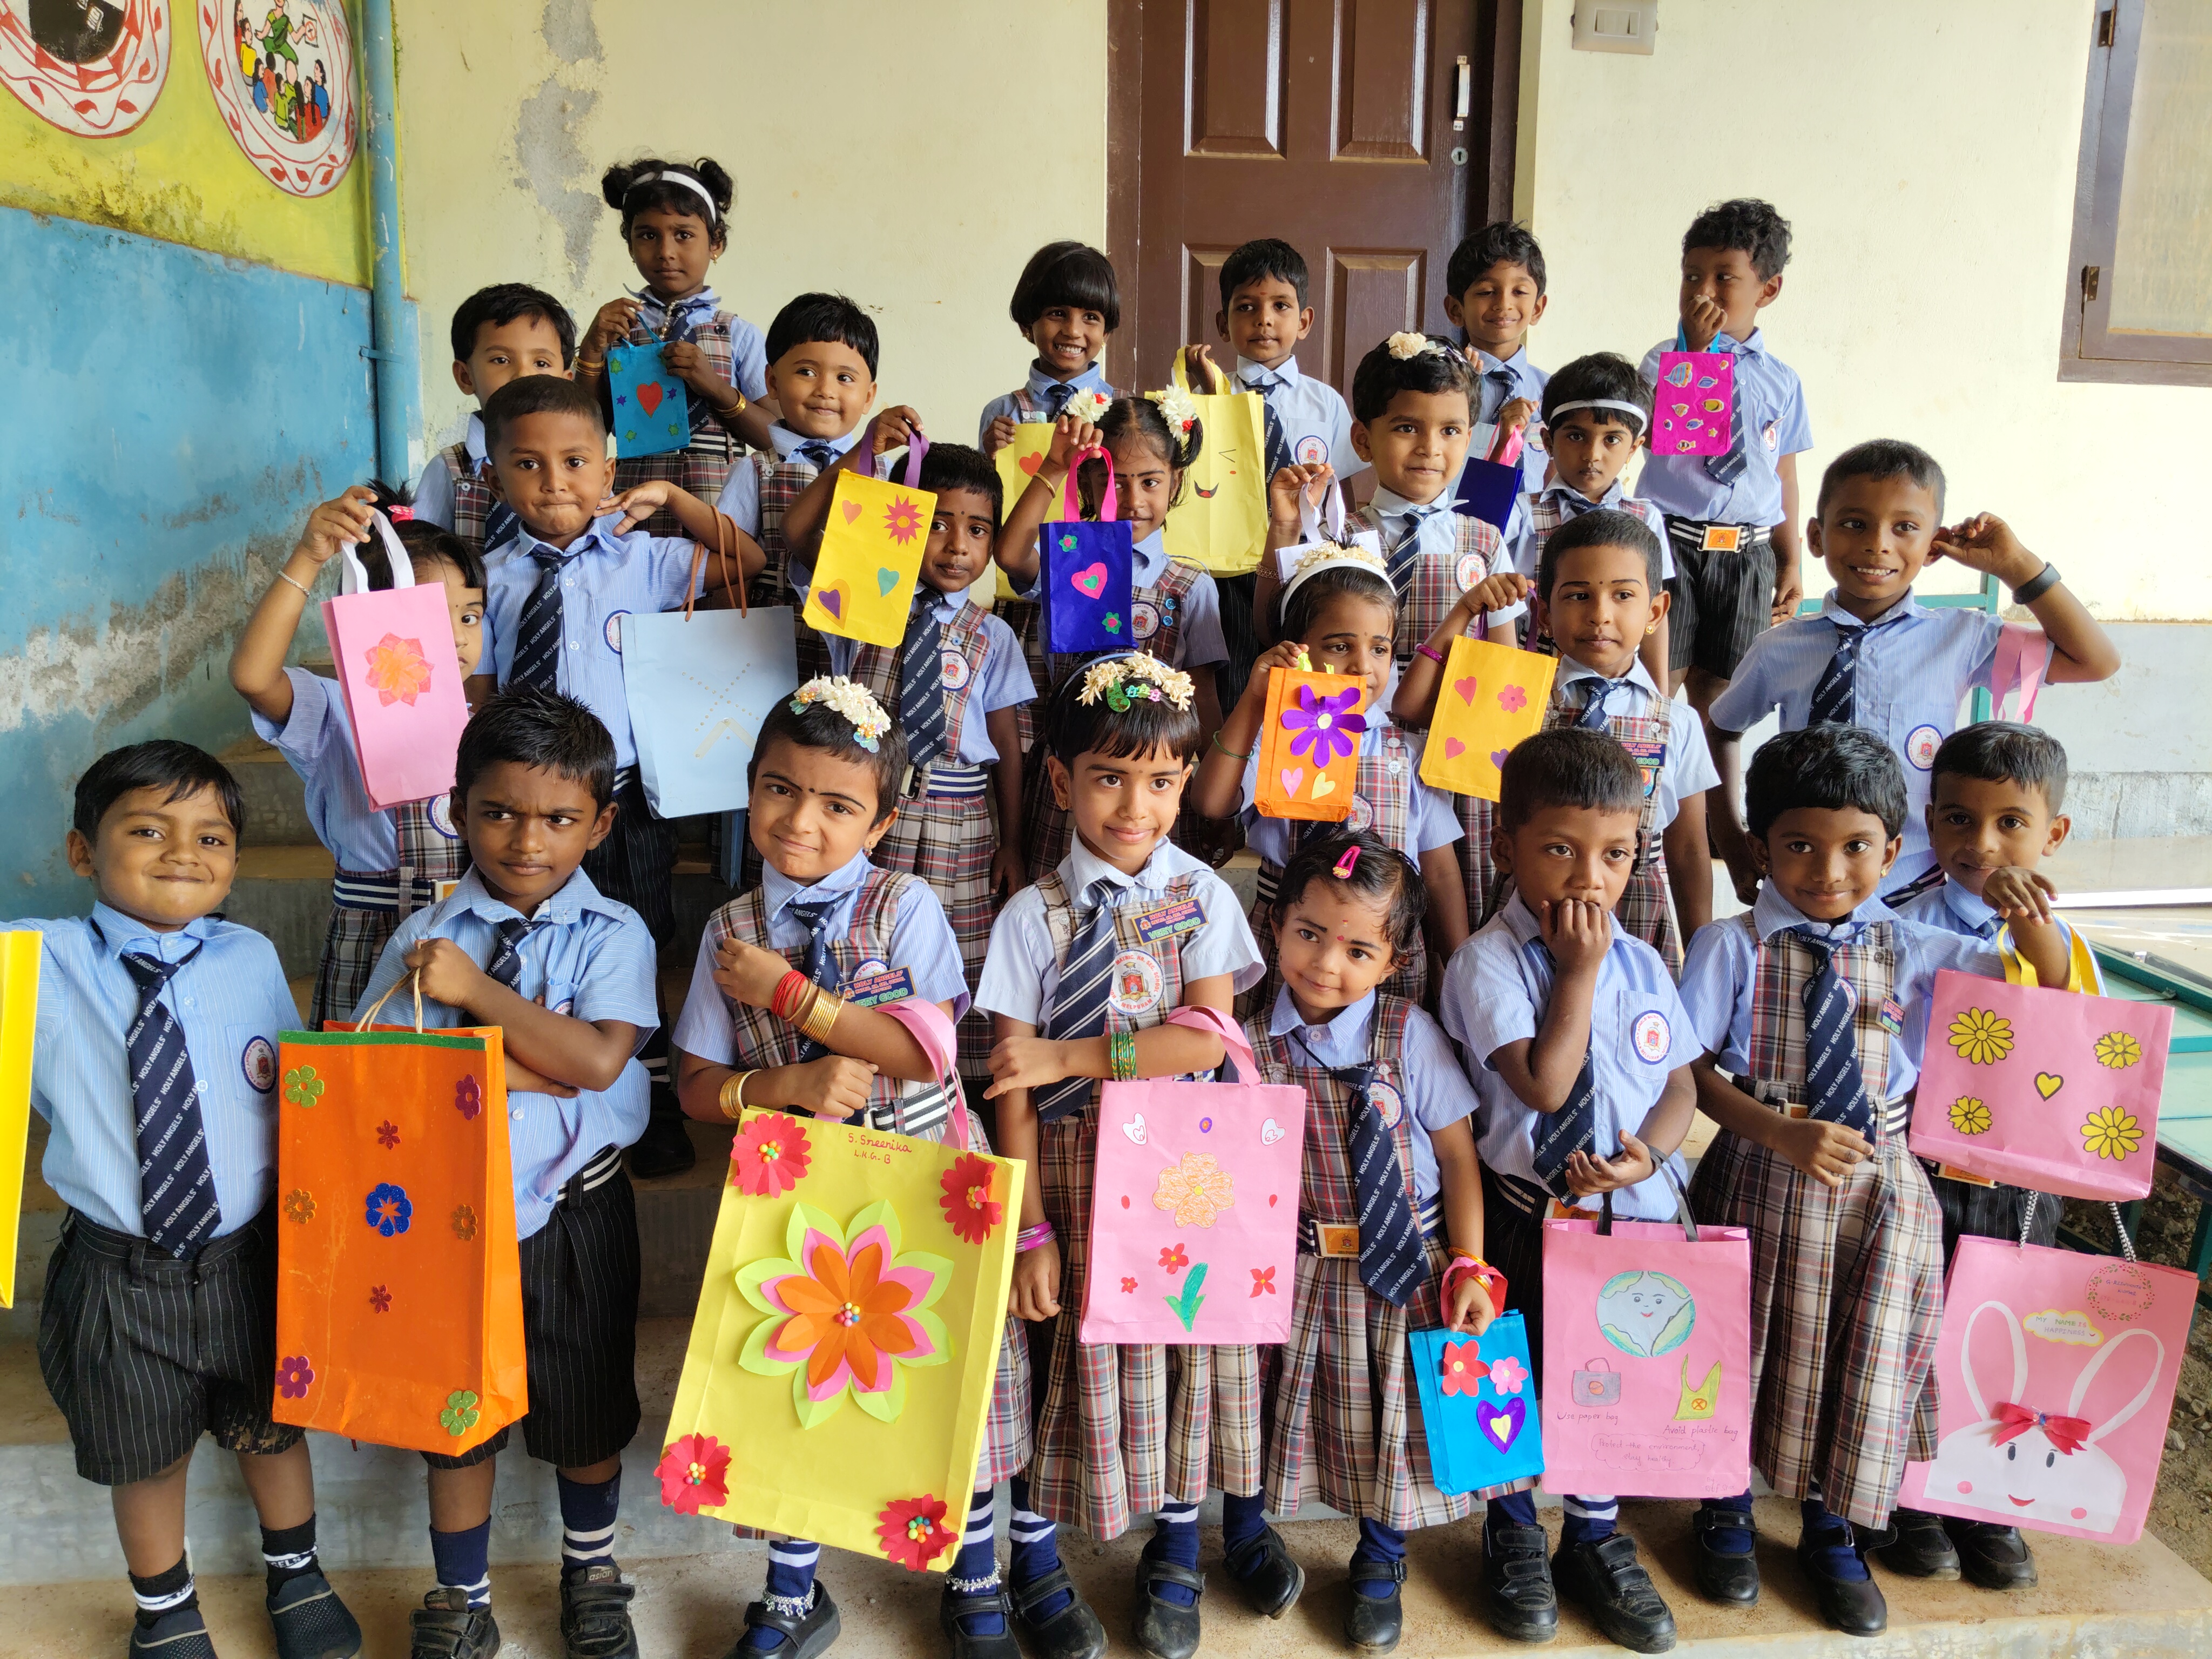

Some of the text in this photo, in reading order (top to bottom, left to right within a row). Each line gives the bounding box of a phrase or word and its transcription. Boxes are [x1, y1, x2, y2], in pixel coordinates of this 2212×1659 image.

[1719, 465, 1729, 475] HOLY
[496, 524, 506, 534] HOLY
[543, 588, 554, 600] HOLY
[527, 600, 542, 620] ANGELS'
[530, 615, 556, 645] HOLY ANGELS'
[542, 648, 553, 660] HOLY
[902, 637, 923, 665] HOLY ANGELS'
[524, 660, 541, 677] ANGELS'
[916, 650, 937, 678] HOLY ANGELS'
[901, 678, 916, 696] ANGELS'
[930, 679, 940, 691] HOLY
[1816, 672, 1842, 703] HOLY ANGELS'
[906, 691, 930, 718] HOLY ANGELS'
[1828, 687, 1854, 717] HOLY ANGELS'
[920, 718, 932, 730] HOLY
[930, 704, 945, 721] ANGELS'
[1580, 711, 1590, 723] HOLY
[919, 741, 934, 757] ANGELS'
[794, 908, 818, 918] ANGELS'
[1149, 901, 1194, 920] HOLY ANGELS'
[1148, 917, 1201, 939] VERY GOOD
[1810, 938, 1835, 952] ANGELS'
[490, 950, 511, 974] ANGELS'
[1115, 955, 1135, 965] MATRIC.
[1147, 961, 1155, 971] SEC.
[854, 970, 903, 989] HOLY ANGELS'
[879, 988, 908, 1002] GOOD
[1121, 998, 1152, 1009] MELPURAM
[1811, 992, 1833, 1030] HOLY ANGELS'
[1830, 1026, 1840, 1044] HOLY
[138, 1035, 166, 1080] HOLY ANGELS'
[1806, 1046, 1832, 1083] HOLY ANGELS'
[160, 1050, 187, 1095] HOLY ANGELS'
[1825, 1060, 1852, 1097] HOLY ANGELS'
[182, 1091, 195, 1111] HOLY
[1579, 1092, 1590, 1108] HOLY
[1846, 1096, 1859, 1111] HOLY
[141, 1097, 161, 1126] ANGELS'
[1359, 1105, 1370, 1121] HOLY
[152, 1113, 183, 1157] HOLY ANGELS'
[1548, 1108, 1577, 1144] HOLY ANGELS'
[1573, 1127, 1594, 1150] ANGELS'
[173, 1128, 204, 1172] HOLY ANGELS'
[1359, 1135, 1380, 1174] HOLY ANGELS'
[196, 1169, 211, 1186] HOLY
[1378, 1171, 1389, 1186] HOLY
[143, 1174, 174, 1215] HOLY ANGELS'
[163, 1188, 196, 1228] HOLY ANGELS'
[1358, 1189, 1380, 1226] HOLY ANGELS'
[186, 1202, 219, 1240] HOLY ANGELS'
[1375, 1201, 1398, 1240] HOLY ANGELS'
[1359, 1242, 1377, 1263] ANGELS'
[1395, 1236, 1407, 1251] HOLY
[1367, 1252, 1397, 1286] HOLY ANGELS'
[1388, 1263, 1417, 1298] HOLY ANGELS'
[2045, 1327, 2085, 1336] HAPPINESS
[1577, 1414, 1601, 1425] paper
[1606, 1412, 1618, 1425] bag
[1663, 1425, 1738, 1441] Avoid plastic bag
